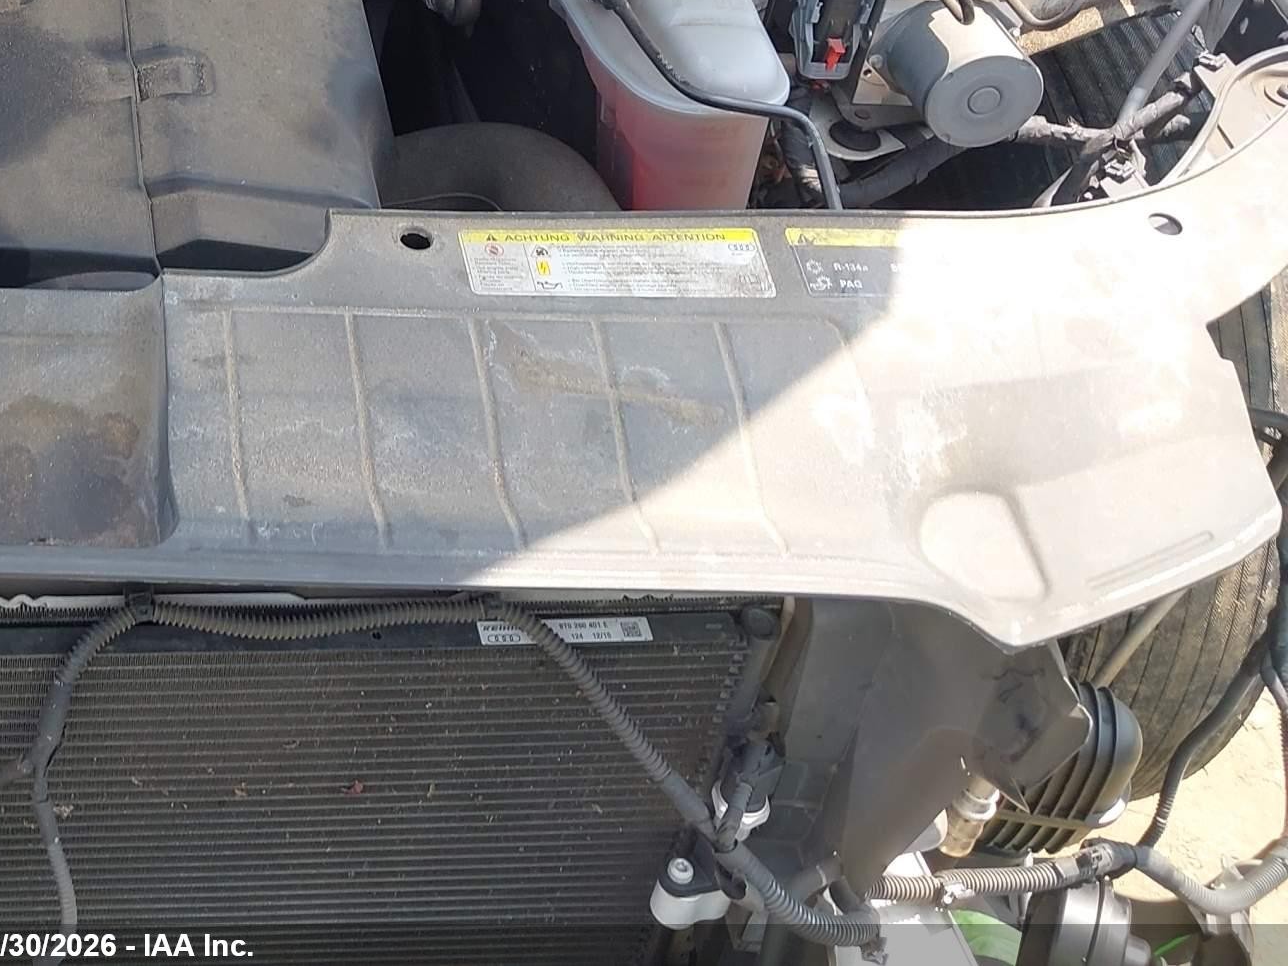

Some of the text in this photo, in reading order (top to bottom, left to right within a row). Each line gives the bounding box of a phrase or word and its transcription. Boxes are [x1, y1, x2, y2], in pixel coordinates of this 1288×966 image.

[504, 233, 726, 242] ACHTUNG WARNING ATTENTION
